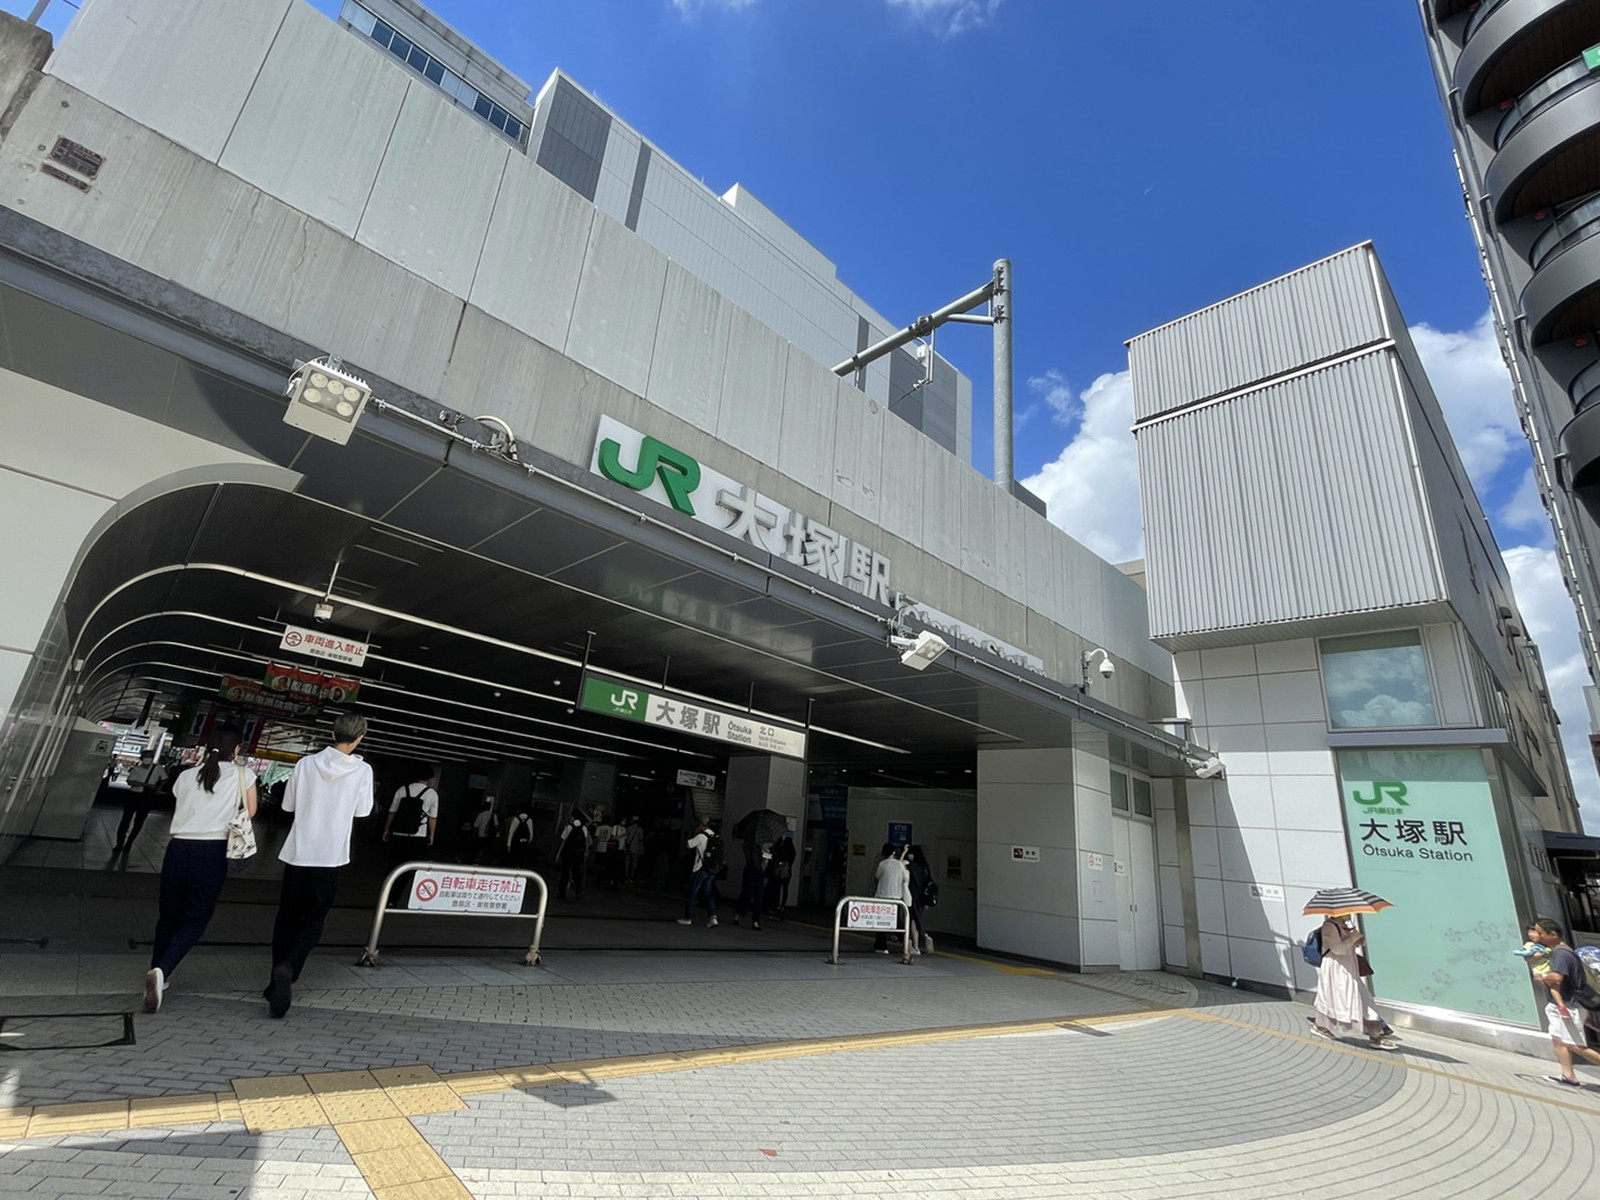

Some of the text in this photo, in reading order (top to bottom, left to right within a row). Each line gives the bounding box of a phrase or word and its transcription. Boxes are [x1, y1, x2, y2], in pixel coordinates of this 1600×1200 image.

[598, 435, 891, 607] JR 大塚駅
[304, 634, 364, 656] 車両進入禁止
[610, 689, 639, 710] JR
[655, 701, 721, 735] 大塚駅
[727, 731, 752, 744] Station
[759, 726, 775, 737] 北口
[1352, 780, 1410, 806] JR
[1363, 807, 1404, 816] JR東日本
[1359, 818, 1468, 846] 大塚駅
[1363, 843, 1474, 862] Ōtsuka Station
[441, 876, 521, 894] 自転車走行禁止
